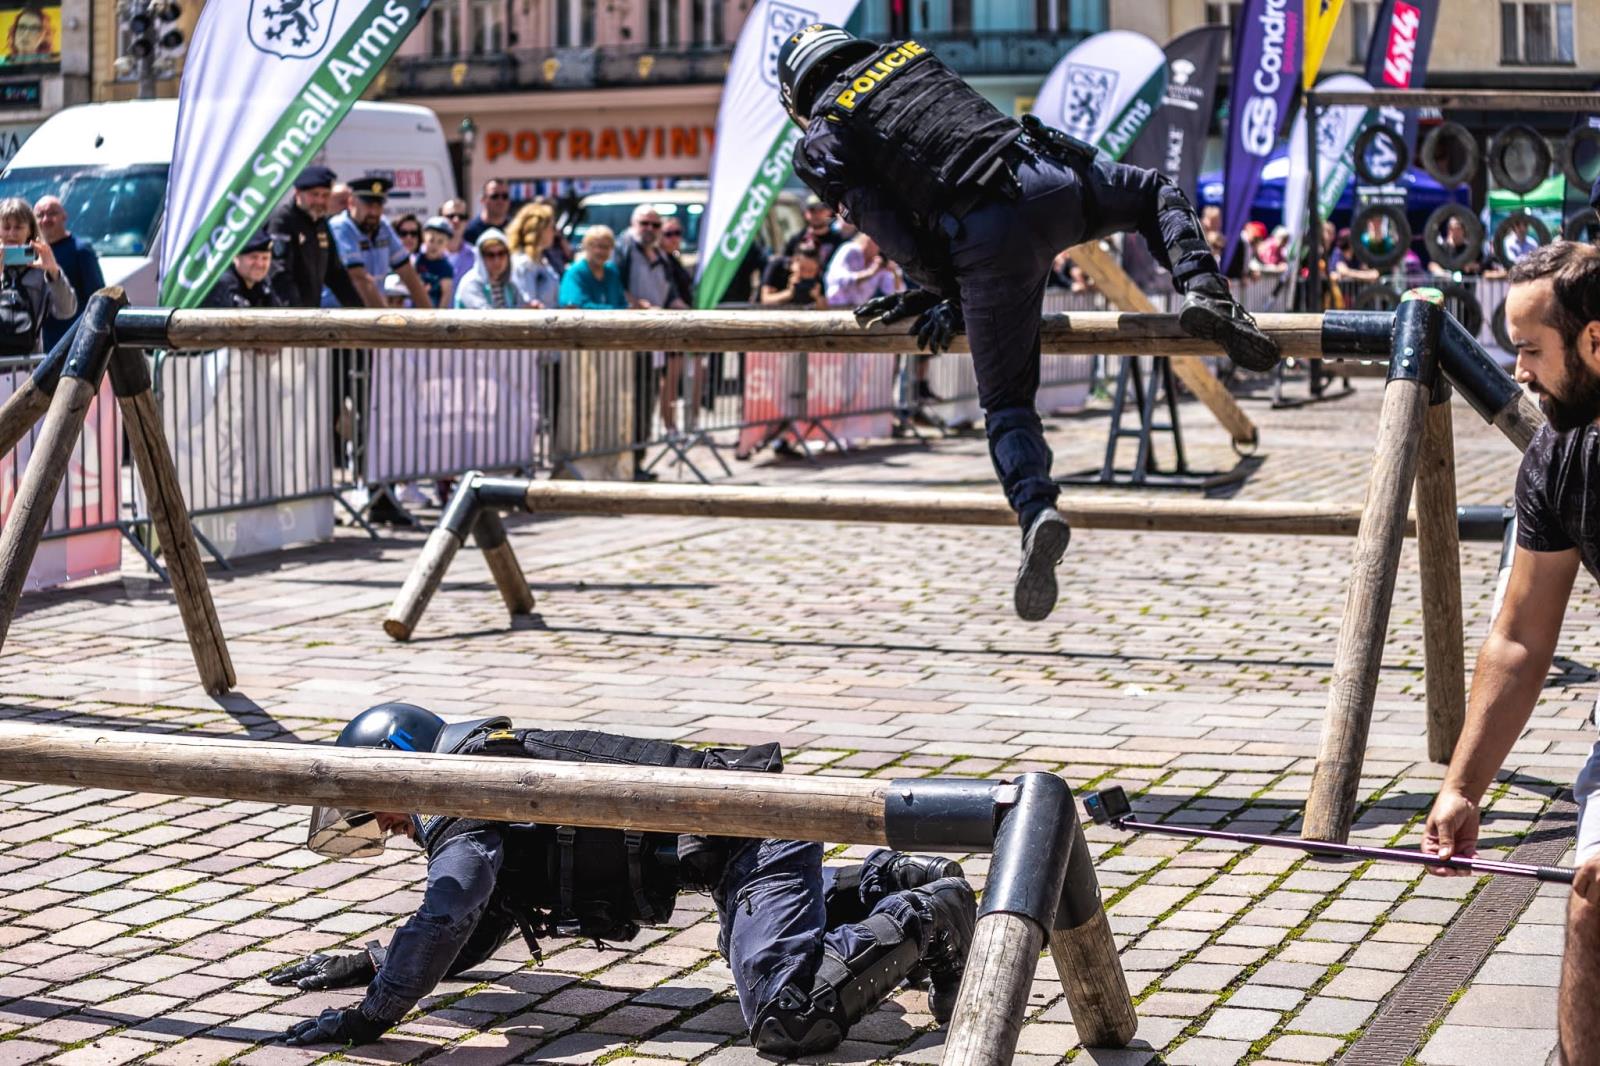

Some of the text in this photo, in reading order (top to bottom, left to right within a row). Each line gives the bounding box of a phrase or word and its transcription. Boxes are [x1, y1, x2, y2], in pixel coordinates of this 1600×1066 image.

[836, 40, 927, 110] POLICIE
[178, 187, 267, 291] Czech
[253, 83, 341, 189] Small
[328, 0, 411, 94] Arms
[1105, 98, 1152, 153] Arms
[720, 184, 773, 260] Czech
